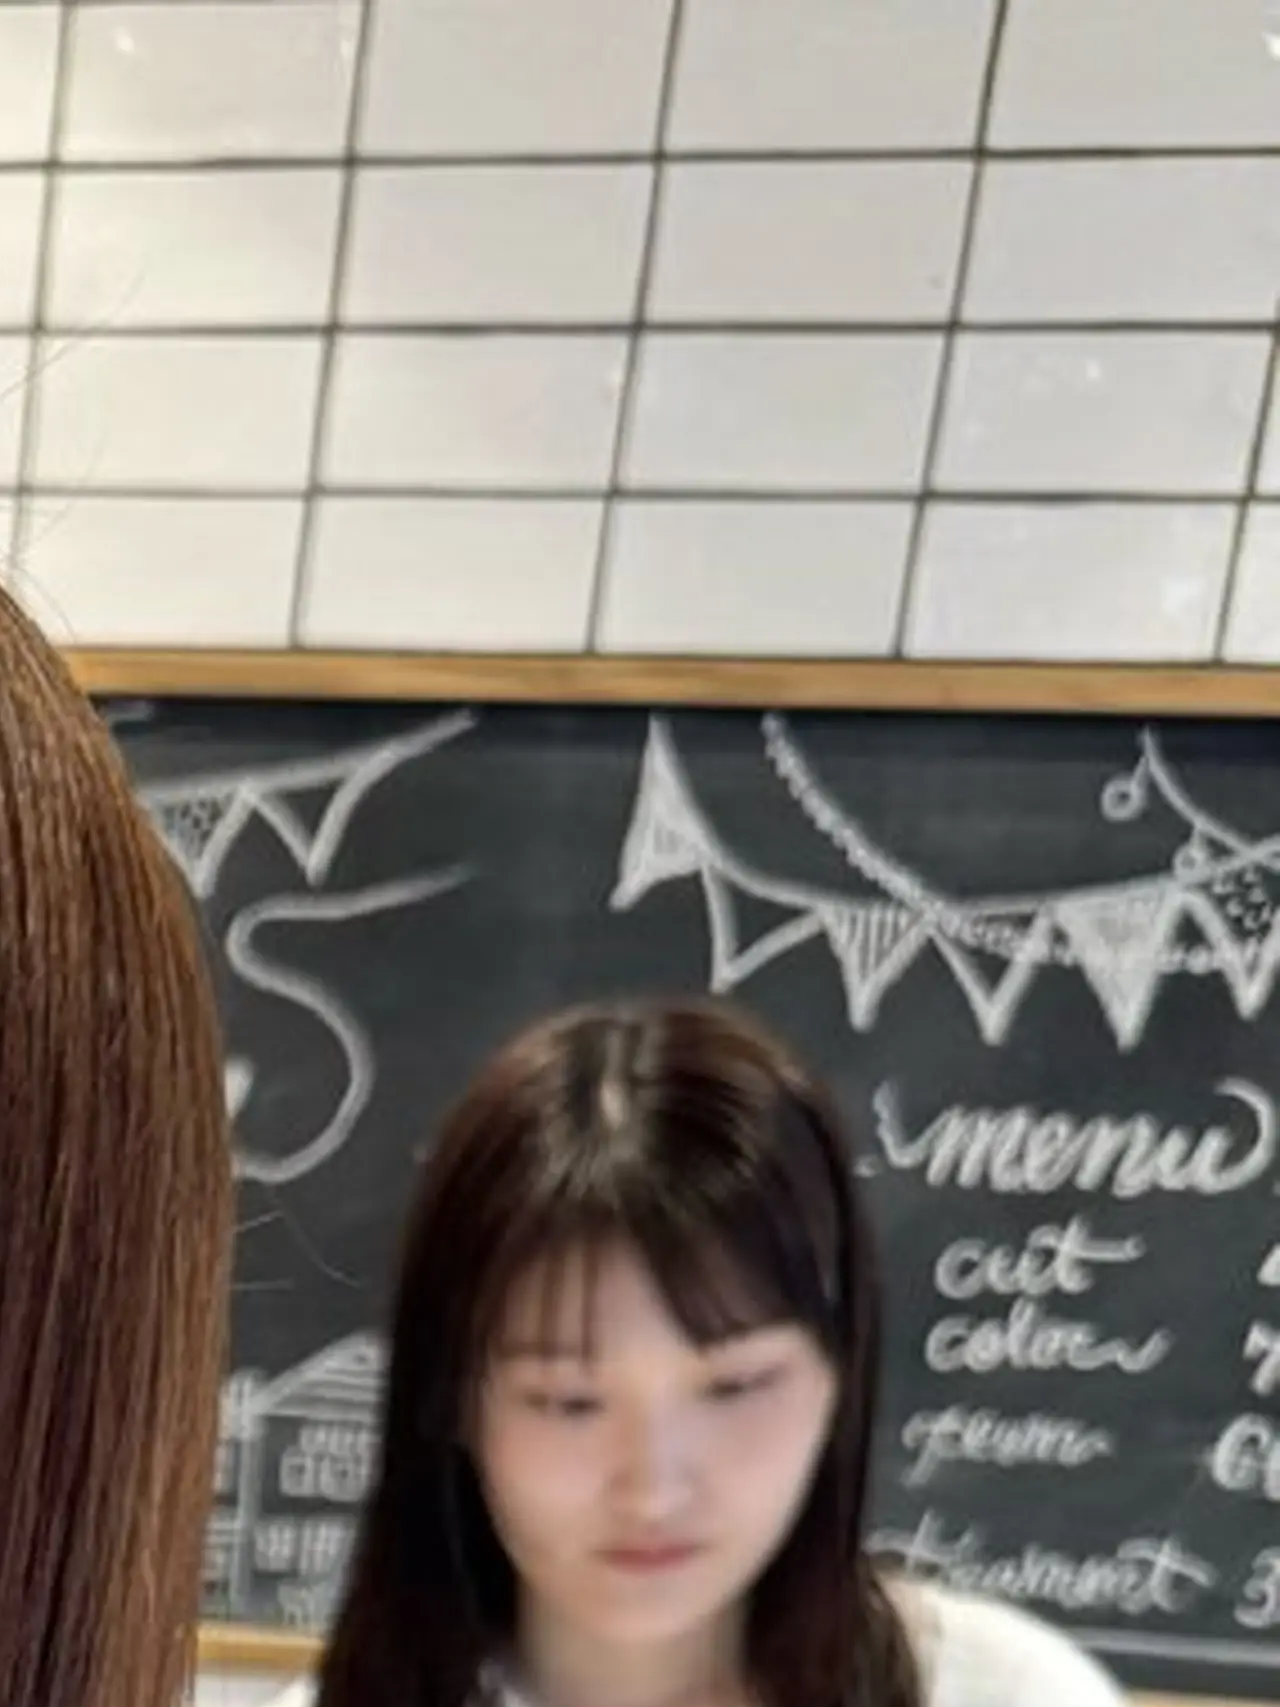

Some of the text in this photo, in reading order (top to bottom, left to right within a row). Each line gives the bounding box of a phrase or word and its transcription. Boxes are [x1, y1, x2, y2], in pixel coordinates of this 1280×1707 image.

[873, 1078, 1276, 1198] menu
[934, 1216, 1145, 1299] cut
[925, 1299, 1172, 1374] color
